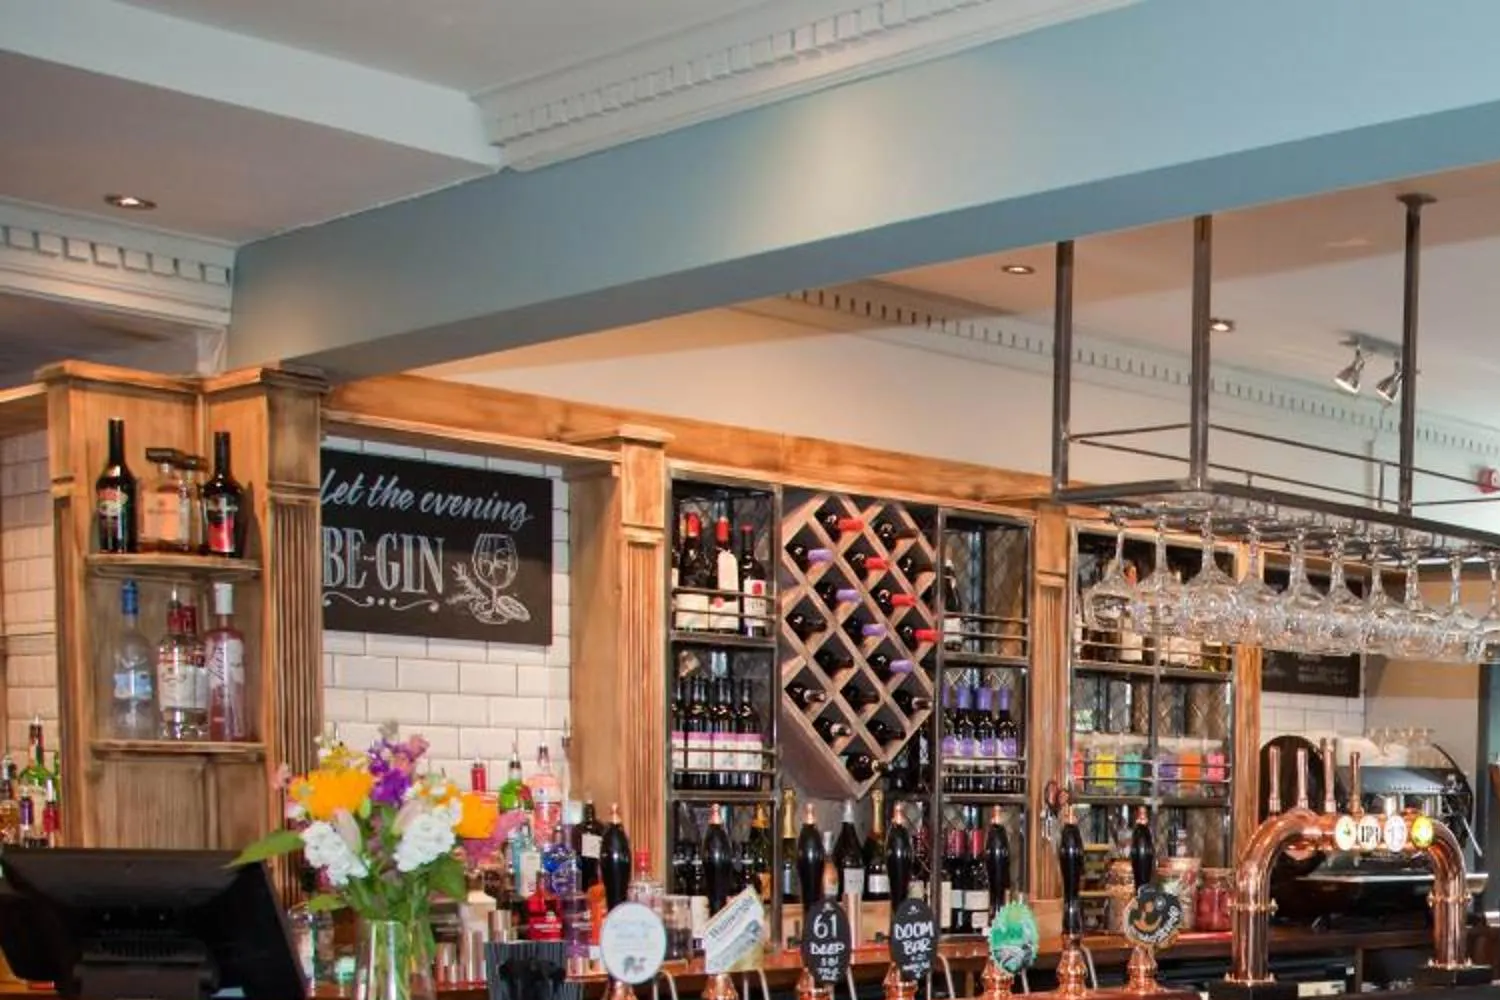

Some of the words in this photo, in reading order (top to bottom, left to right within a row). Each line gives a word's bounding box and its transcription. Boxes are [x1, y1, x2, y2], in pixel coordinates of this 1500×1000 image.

[367, 474, 415, 511] the
[419, 491, 535, 532] evening
[813, 913, 838, 938] 61
[894, 921, 935, 940] DOOM
[902, 938, 932, 955] BAR
